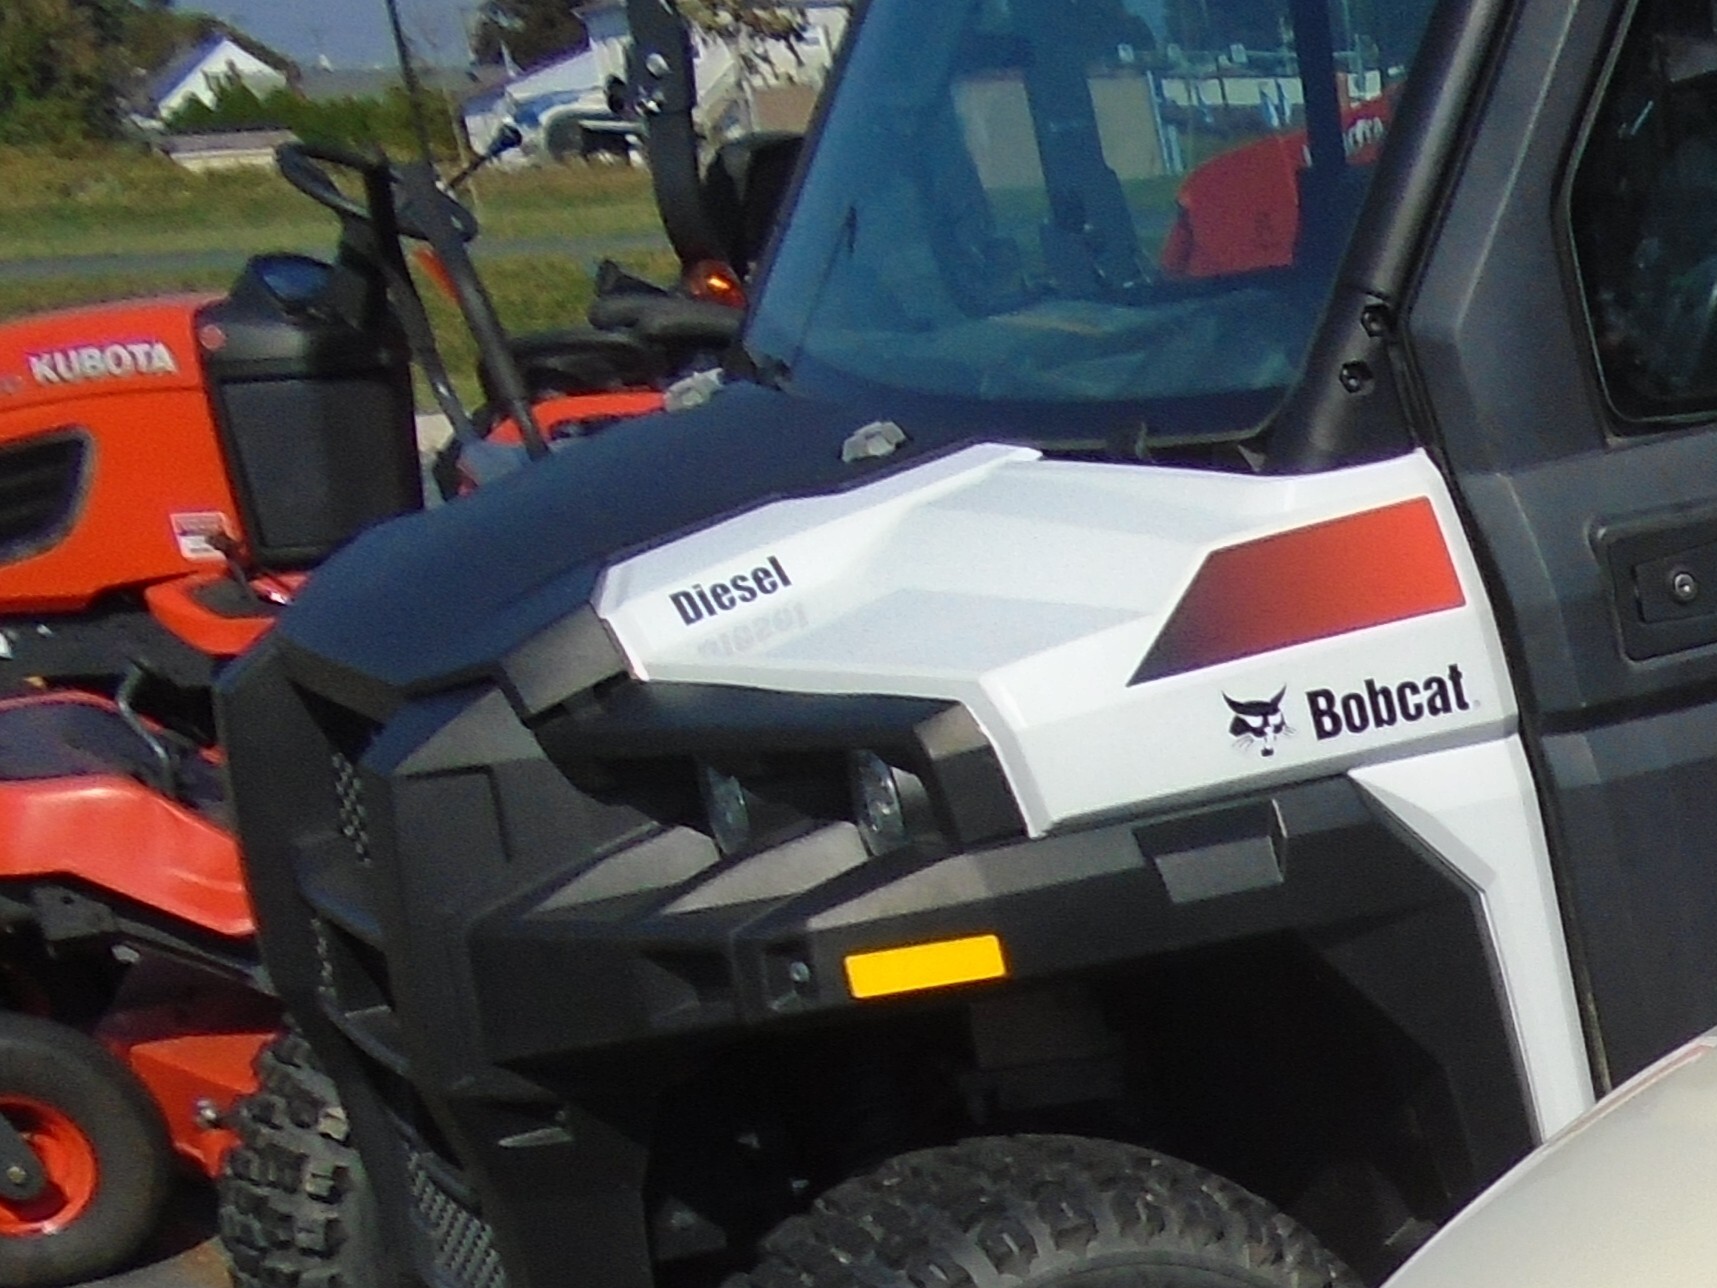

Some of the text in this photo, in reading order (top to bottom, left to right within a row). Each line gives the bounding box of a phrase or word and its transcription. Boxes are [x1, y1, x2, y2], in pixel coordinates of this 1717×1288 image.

[28, 341, 177, 384] KUBOTA
[669, 555, 792, 626] Diesel
[1306, 663, 1469, 741] Bobcat
